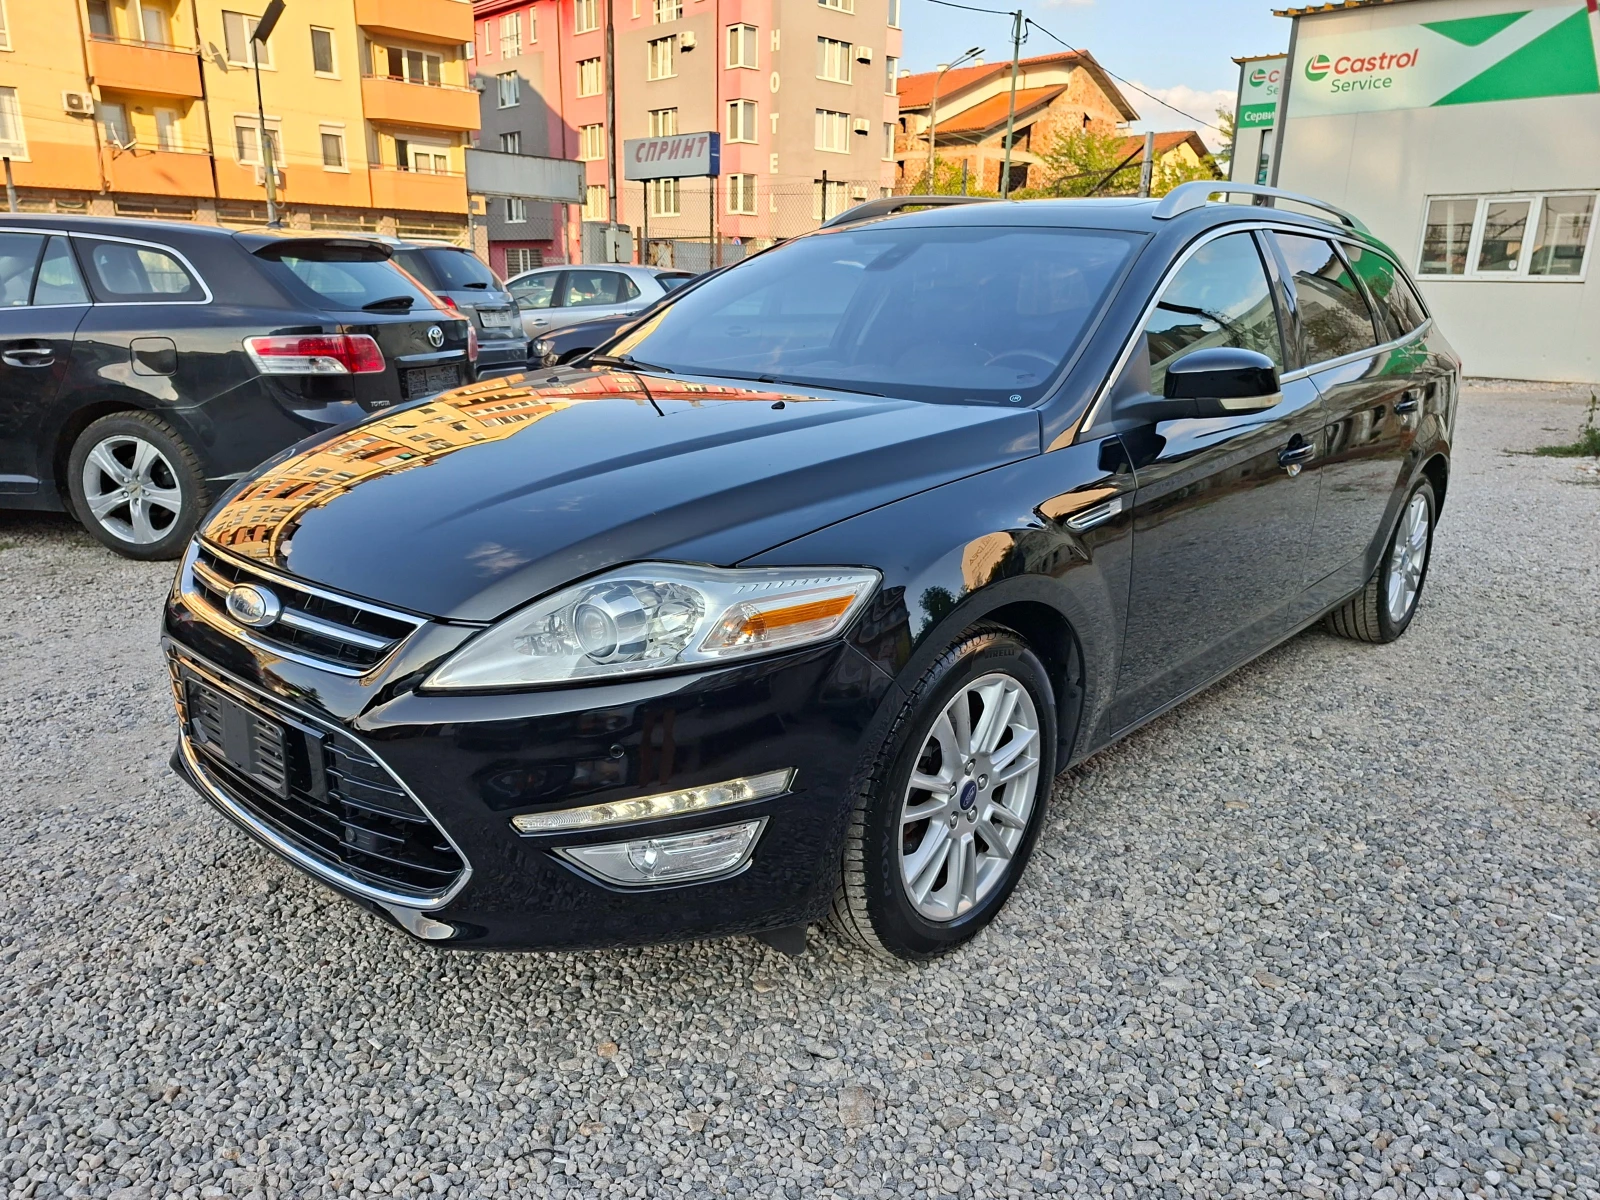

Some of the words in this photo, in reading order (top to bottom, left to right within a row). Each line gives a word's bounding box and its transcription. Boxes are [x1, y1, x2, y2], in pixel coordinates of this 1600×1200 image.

[1333, 48, 1419, 75] Castrol
[1330, 75, 1392, 93] Service
[769, 28, 781, 213] HOTEL
[1244, 110, 1275, 123] Серви
[635, 136, 708, 163] СПРИНТ
[881, 789, 898, 897] POWER
